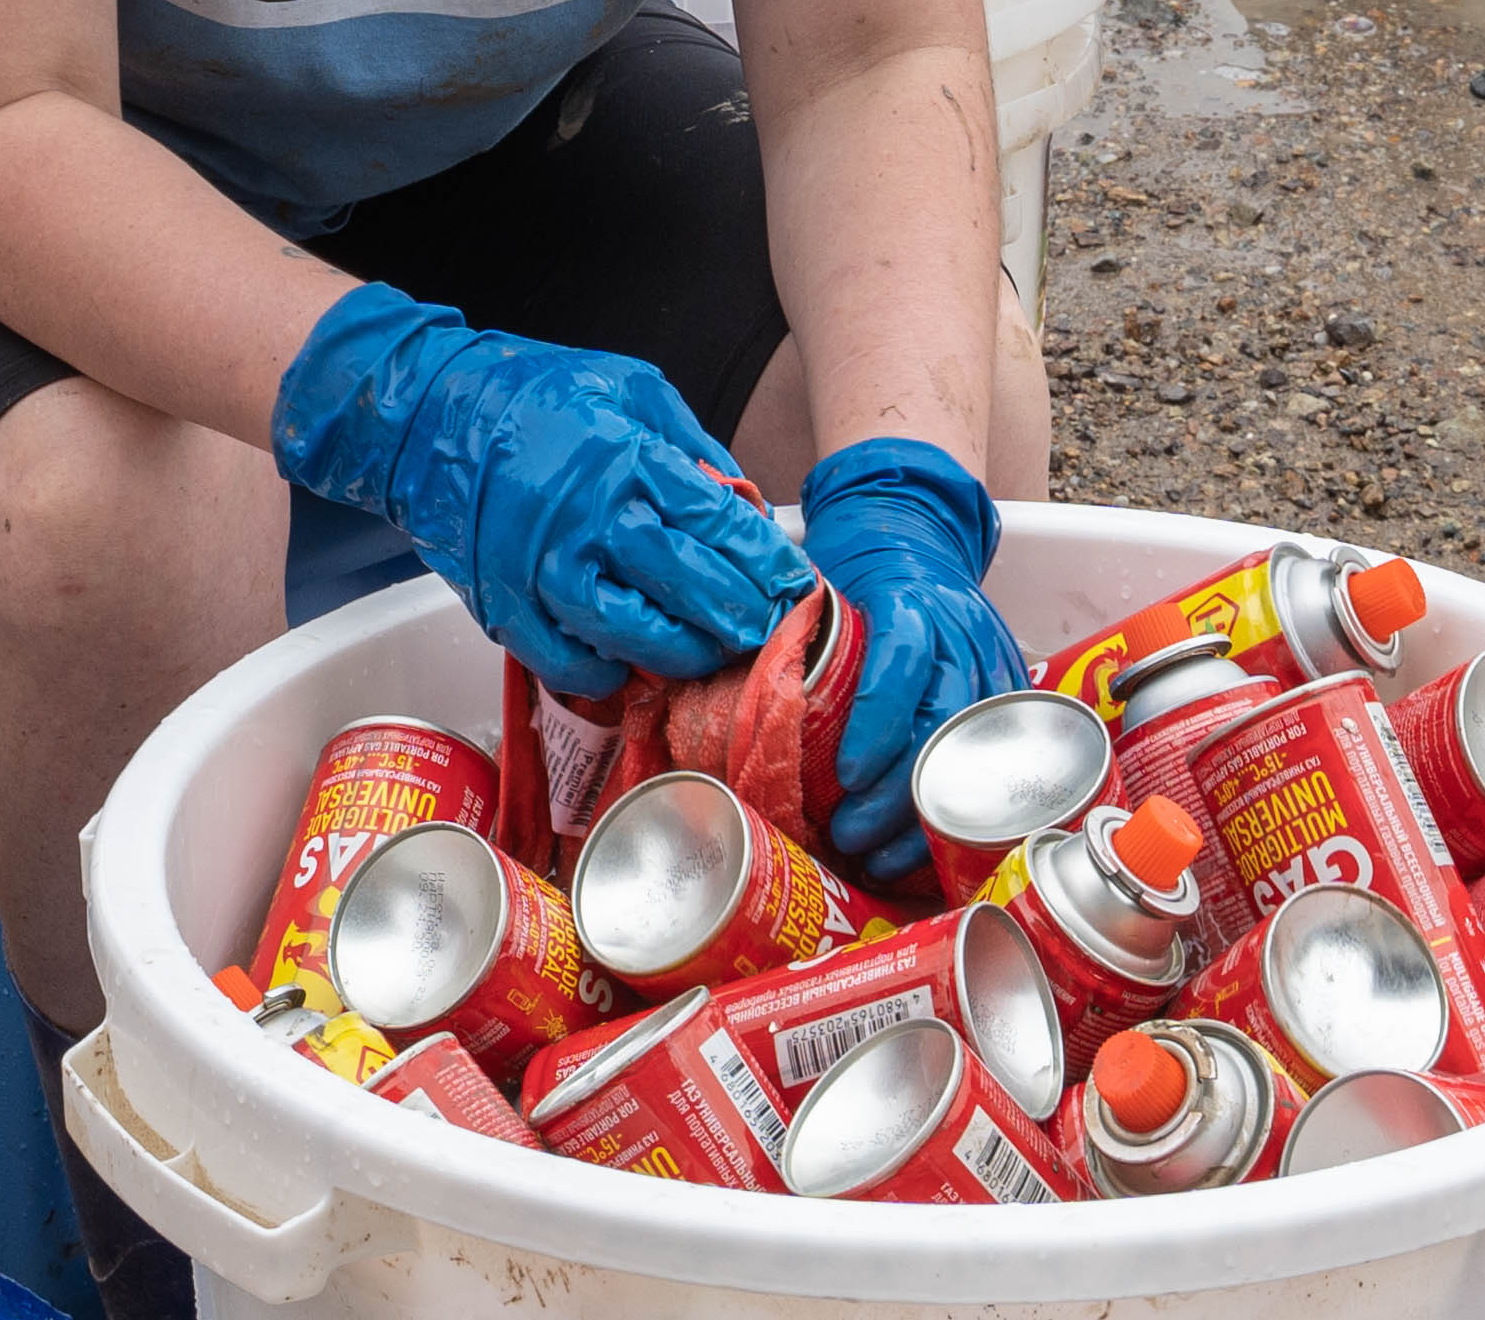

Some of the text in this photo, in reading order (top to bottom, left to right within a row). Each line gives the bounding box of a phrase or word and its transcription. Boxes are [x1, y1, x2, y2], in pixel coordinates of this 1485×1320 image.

[1246, 731, 1287, 759] PORTABLE
[1287, 723, 1307, 740] FOR
[391, 743, 431, 760] PORTABLE
[432, 752, 450, 767] FOR
[1230, 752, 1247, 766] GAS
[1304, 756, 1321, 773] ГАЗ
[427, 782, 441, 794] ГАЗ
[566, 754, 593, 806] Premier
[318, 780, 436, 821] UNIVERSAL
[1346, 744, 1383, 822] портативных
[1400, 873, 1434, 931] приборов
[1356, 743, 1446, 927] УНИВЕРСАЛЬНЫЙ ВСЕСЕЗОННЫЙ
[801, 955, 917, 1004] ГАЗ УНИВЕРСАЛЬНЫЙ
[825, 952, 895, 983] портативных
[778, 971, 824, 997] газовых
[850, 998, 903, 1025] 680165
[1446, 977, 1474, 1026] portable
[1467, 1028, 1485, 1050] gas
[790, 1017, 842, 1043] 203575
[680, 1078, 697, 1100] ГАЗ
[720, 1073, 757, 1127] 680165
[566, 1098, 639, 1154] FOR PORTABLE GAS
[643, 1131, 659, 1146] ГАЗ
[685, 1111, 741, 1190] портативных
[940, 1182, 959, 1202] ГАЗ
